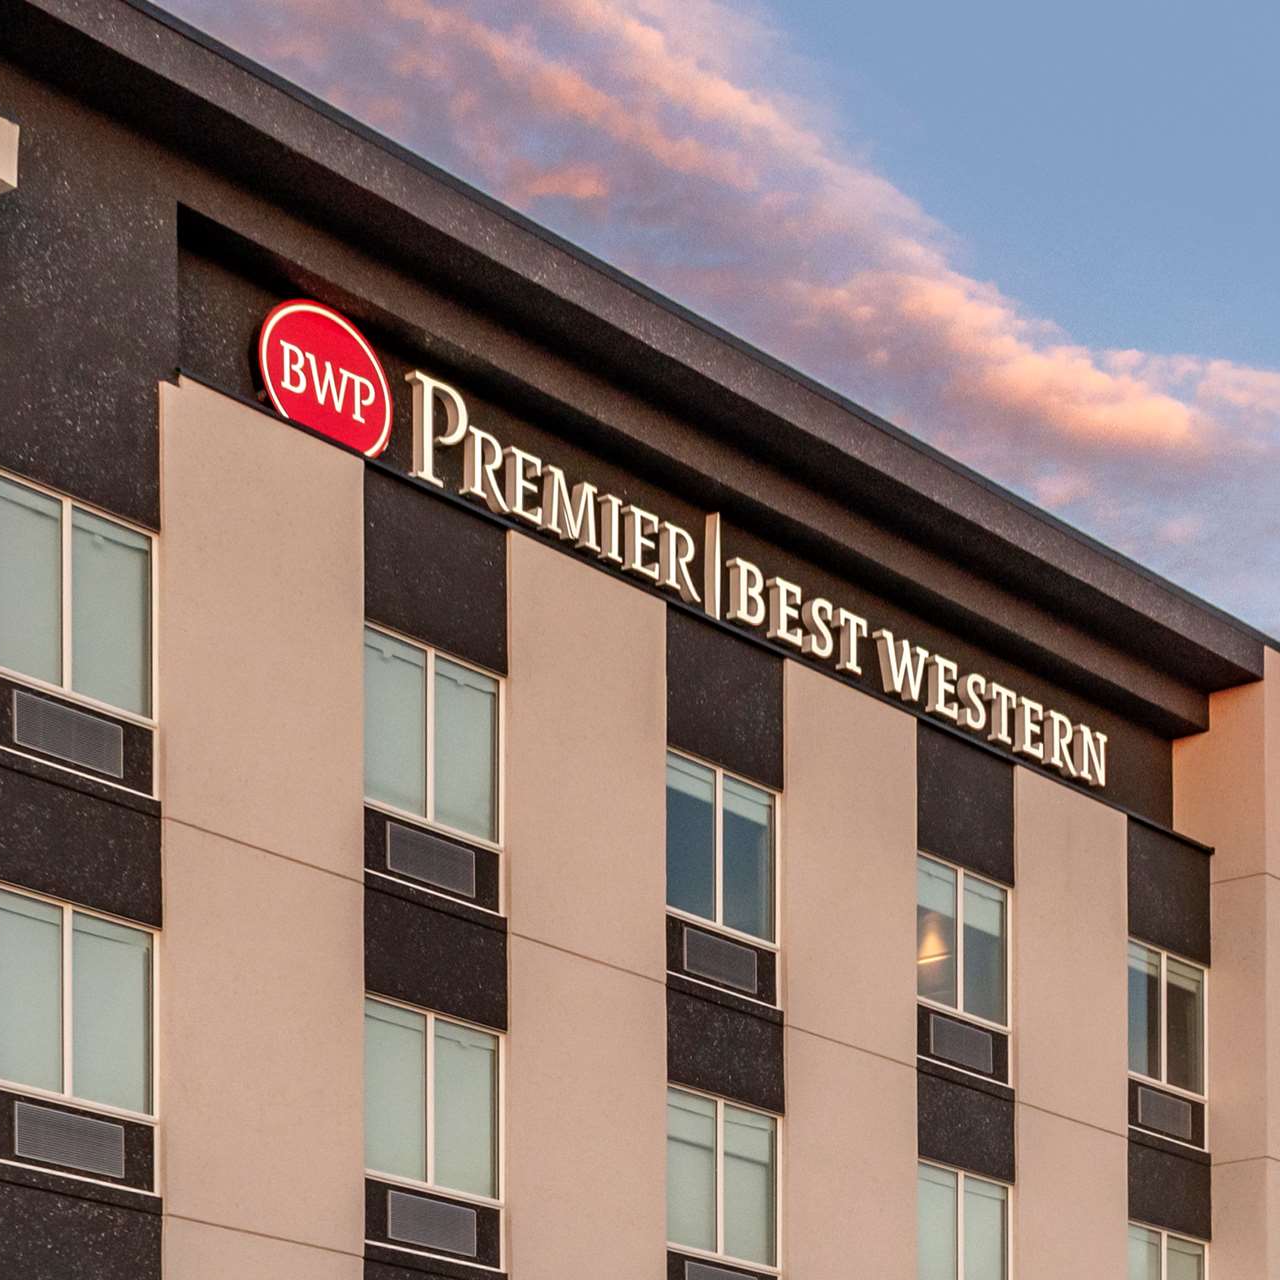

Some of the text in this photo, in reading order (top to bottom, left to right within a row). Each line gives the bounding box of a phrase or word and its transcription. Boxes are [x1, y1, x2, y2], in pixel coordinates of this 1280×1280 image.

[279, 338, 376, 425] BWP
[405, 369, 1108, 787] PREMIER BEST WESTERN
